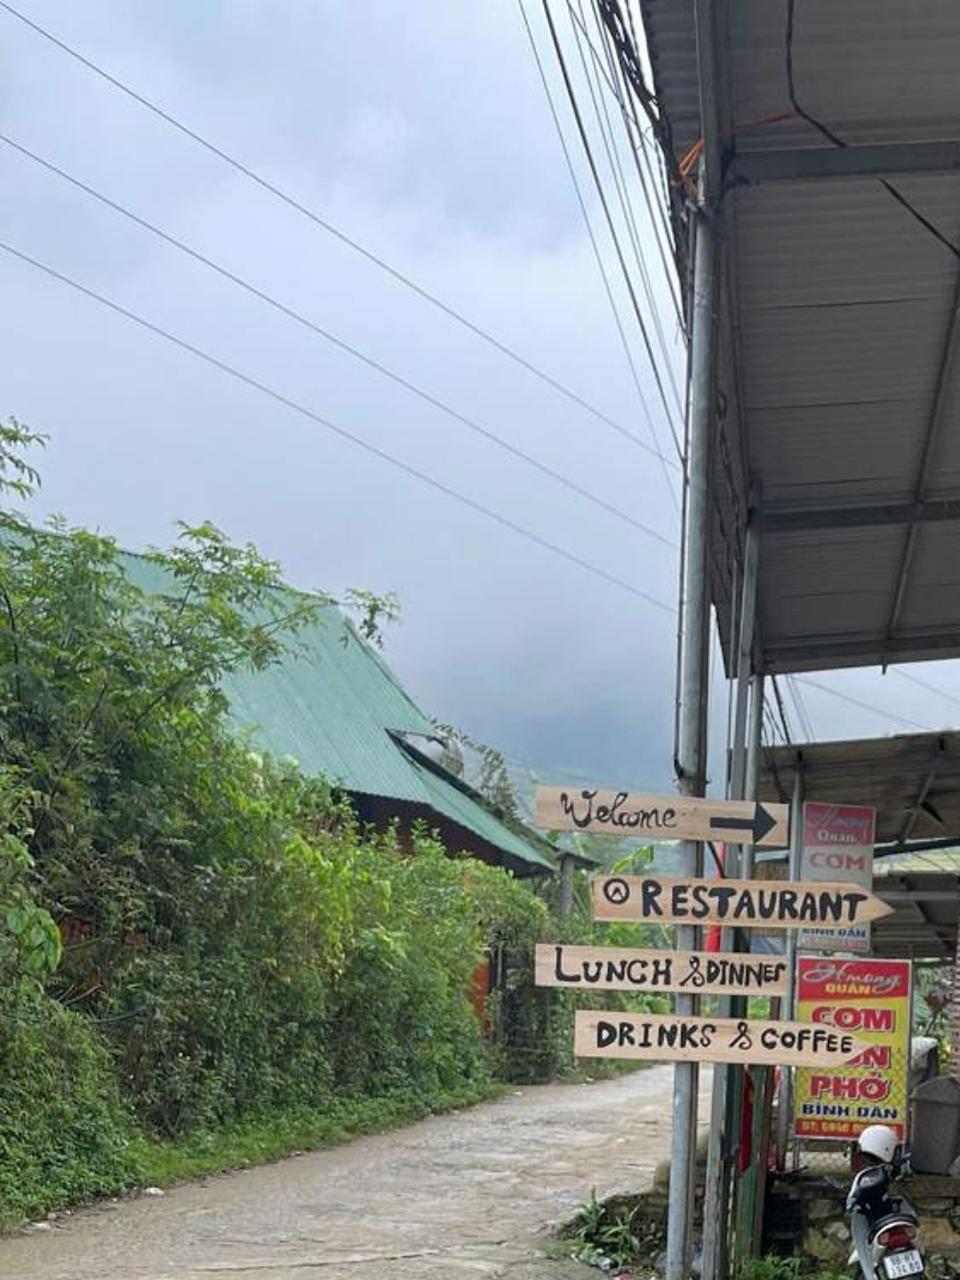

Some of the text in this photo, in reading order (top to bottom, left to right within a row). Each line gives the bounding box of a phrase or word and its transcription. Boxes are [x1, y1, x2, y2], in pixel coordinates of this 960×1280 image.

[560, 789, 678, 829] Welcome
[641, 880, 868, 922] RESTAURANT
[554, 946, 672, 985] LUNCH
[596, 1020, 716, 1048] DRINKS
[761, 1027, 853, 1055] COFFEE
